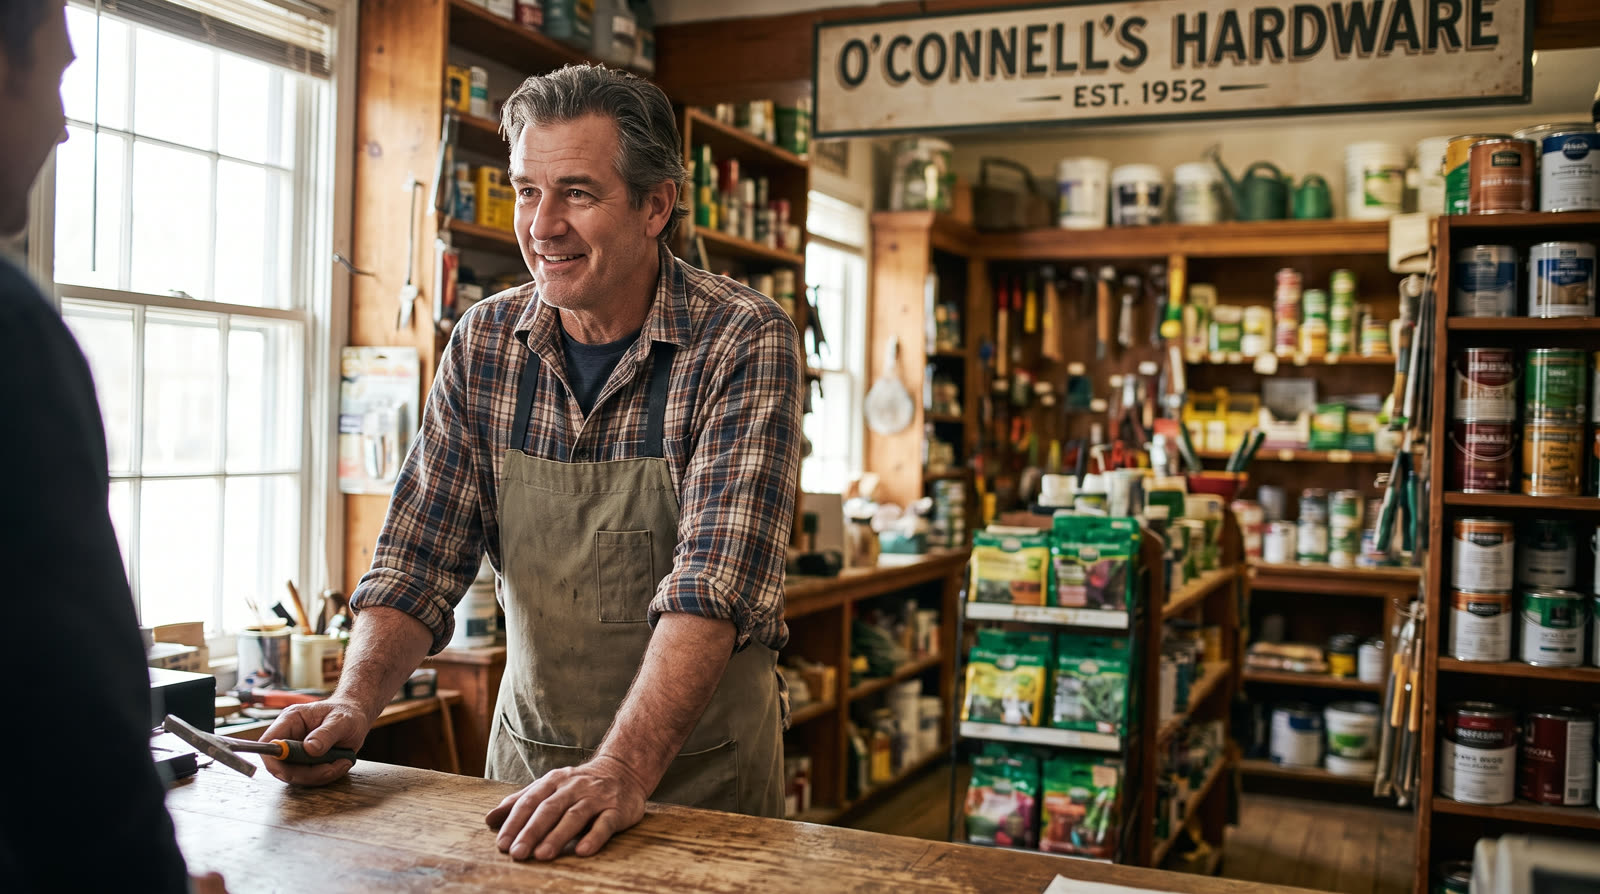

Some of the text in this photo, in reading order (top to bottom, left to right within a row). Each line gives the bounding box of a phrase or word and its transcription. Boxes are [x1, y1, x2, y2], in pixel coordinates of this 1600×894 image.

[837, 0, 1500, 90] O'CONNELL'S HARDWARE
[1073, 79, 1206, 108] EST. 1952
